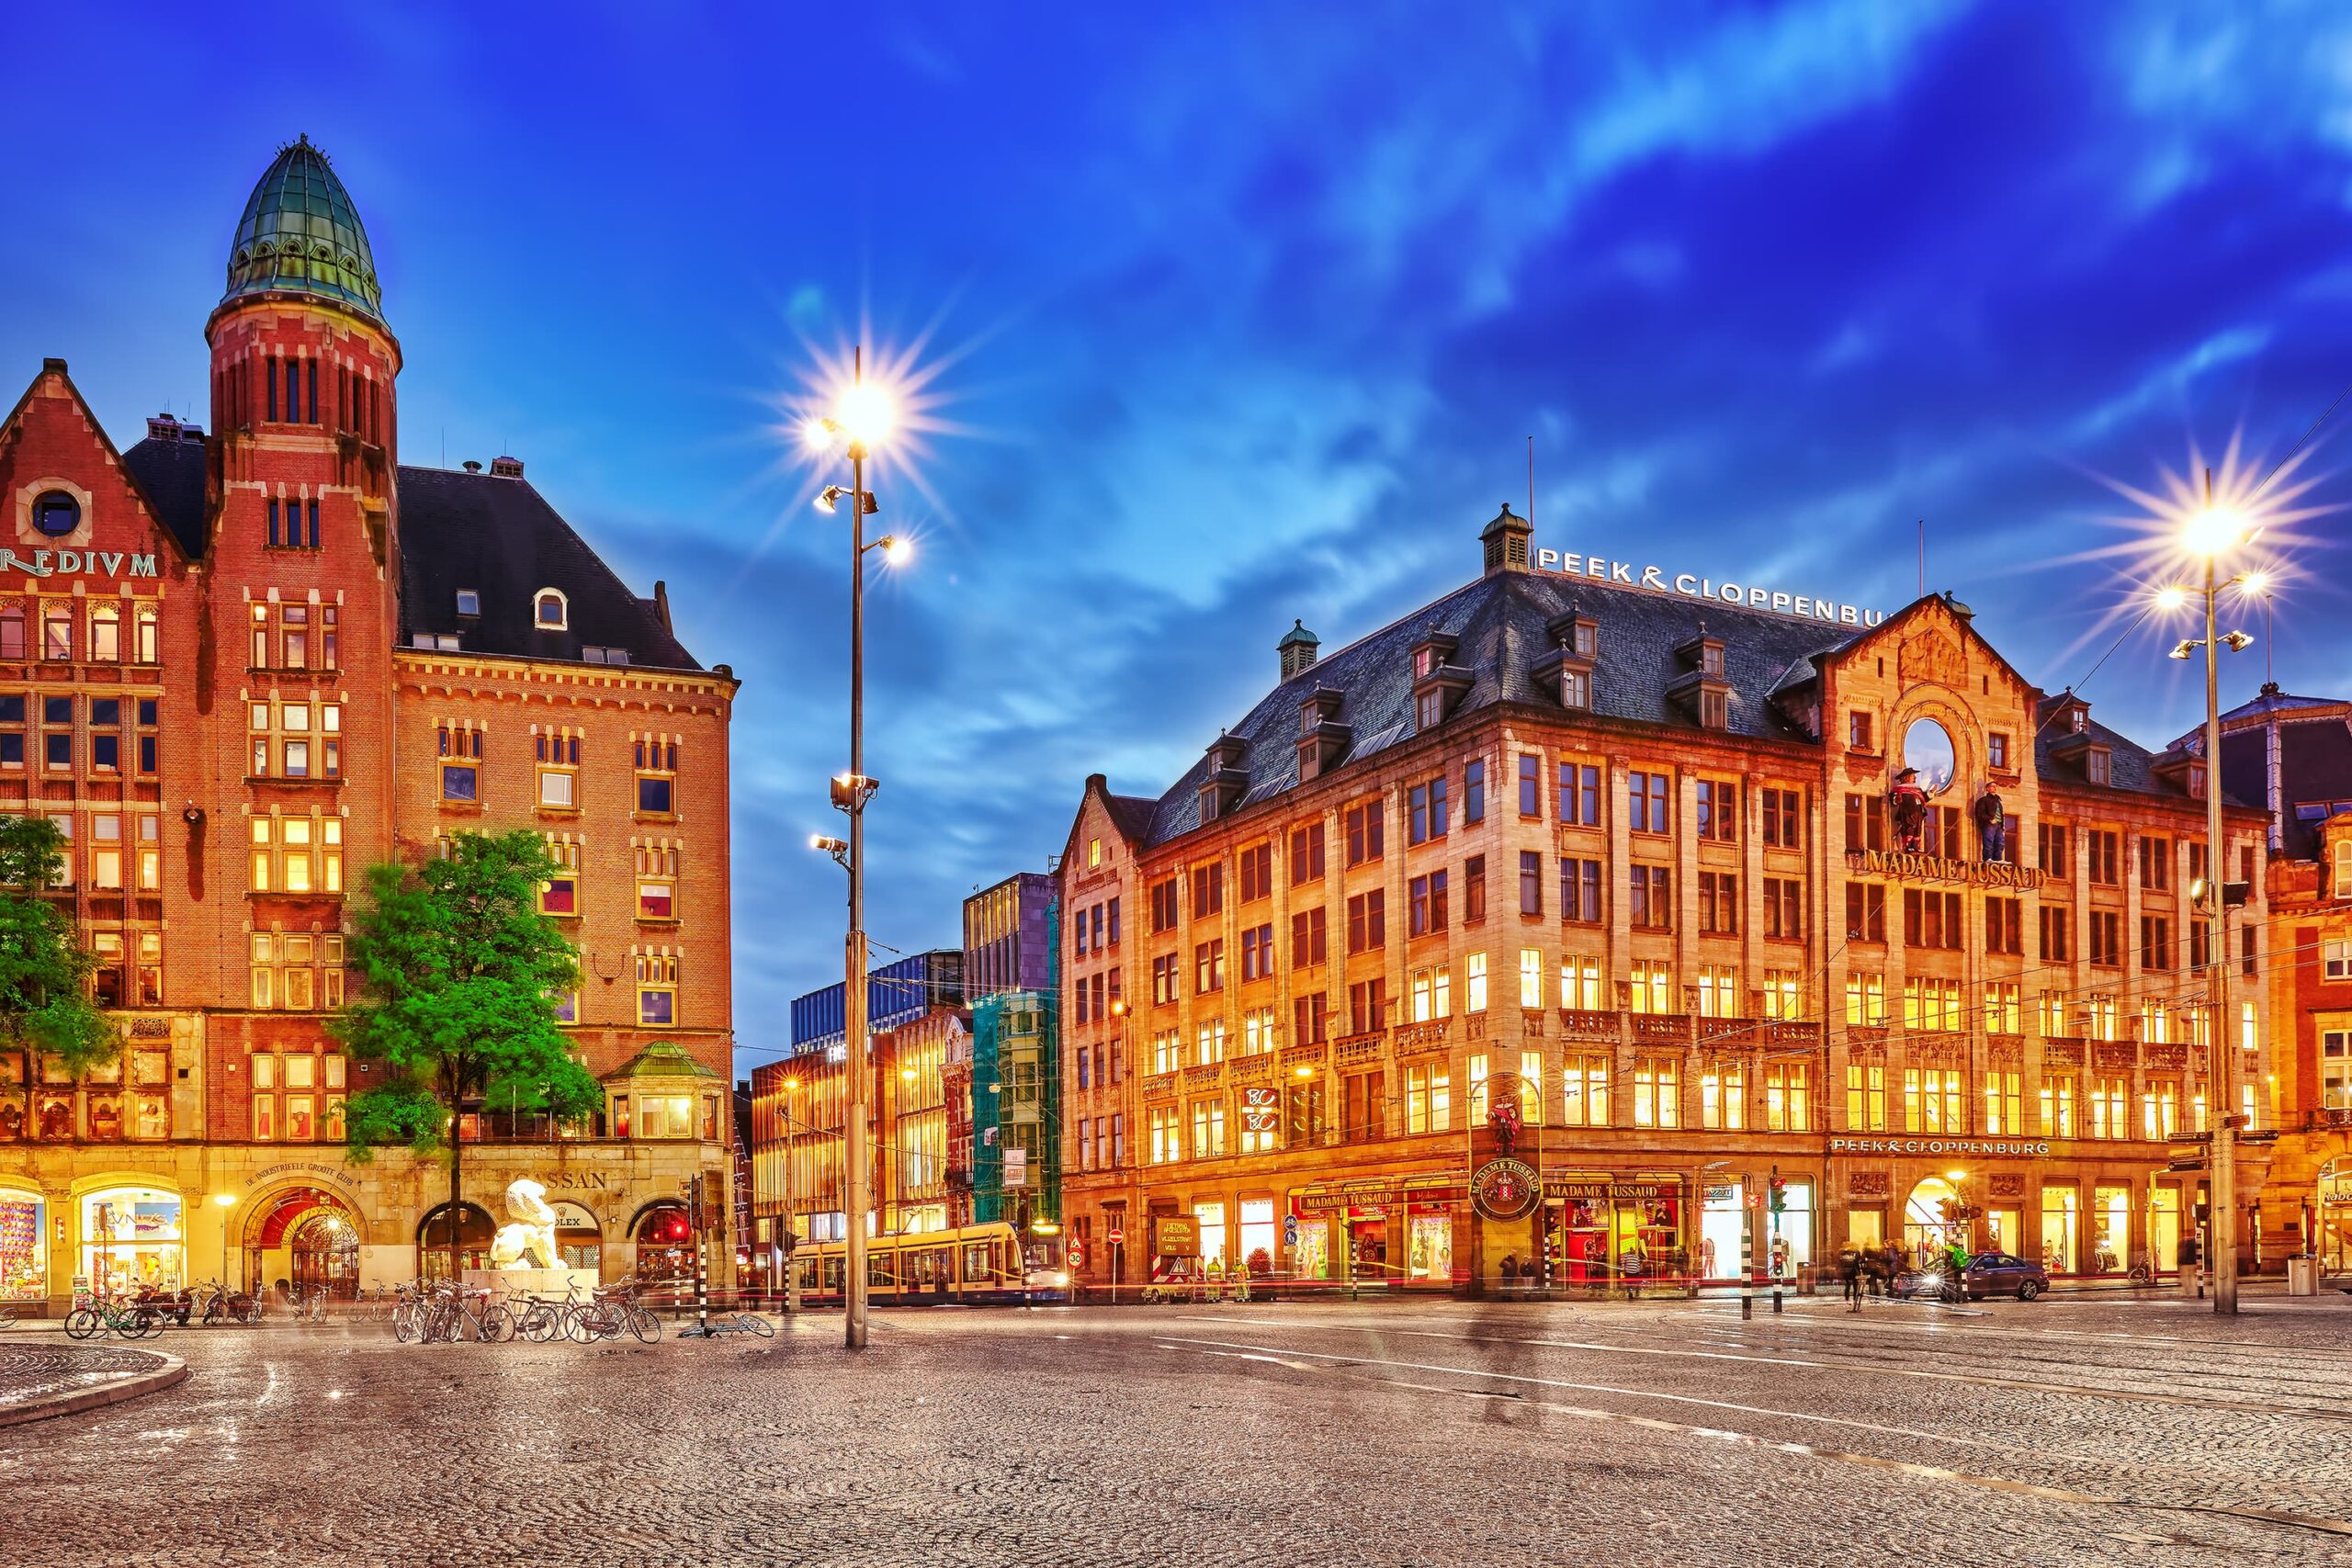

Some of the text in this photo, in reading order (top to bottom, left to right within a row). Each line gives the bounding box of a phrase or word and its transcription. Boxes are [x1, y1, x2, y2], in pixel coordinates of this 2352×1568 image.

[1674, 574, 1883, 627] CLOPPENBU
[1865, 850, 2047, 887] MADAME TUSSAUD
[245, 1162, 354, 1187] DE INDUSTRIEELE GROOTE CLUB
[1471, 1161, 1540, 1194] MADAME TUSSAUD
[1306, 1192, 1393, 1208] MADAME TUSSAUD
[1550, 1185, 1657, 1198] MADAME TUSSAUD
[554, 1218, 581, 1226] OLEX
[1069, 1254, 1081, 1263] 30
